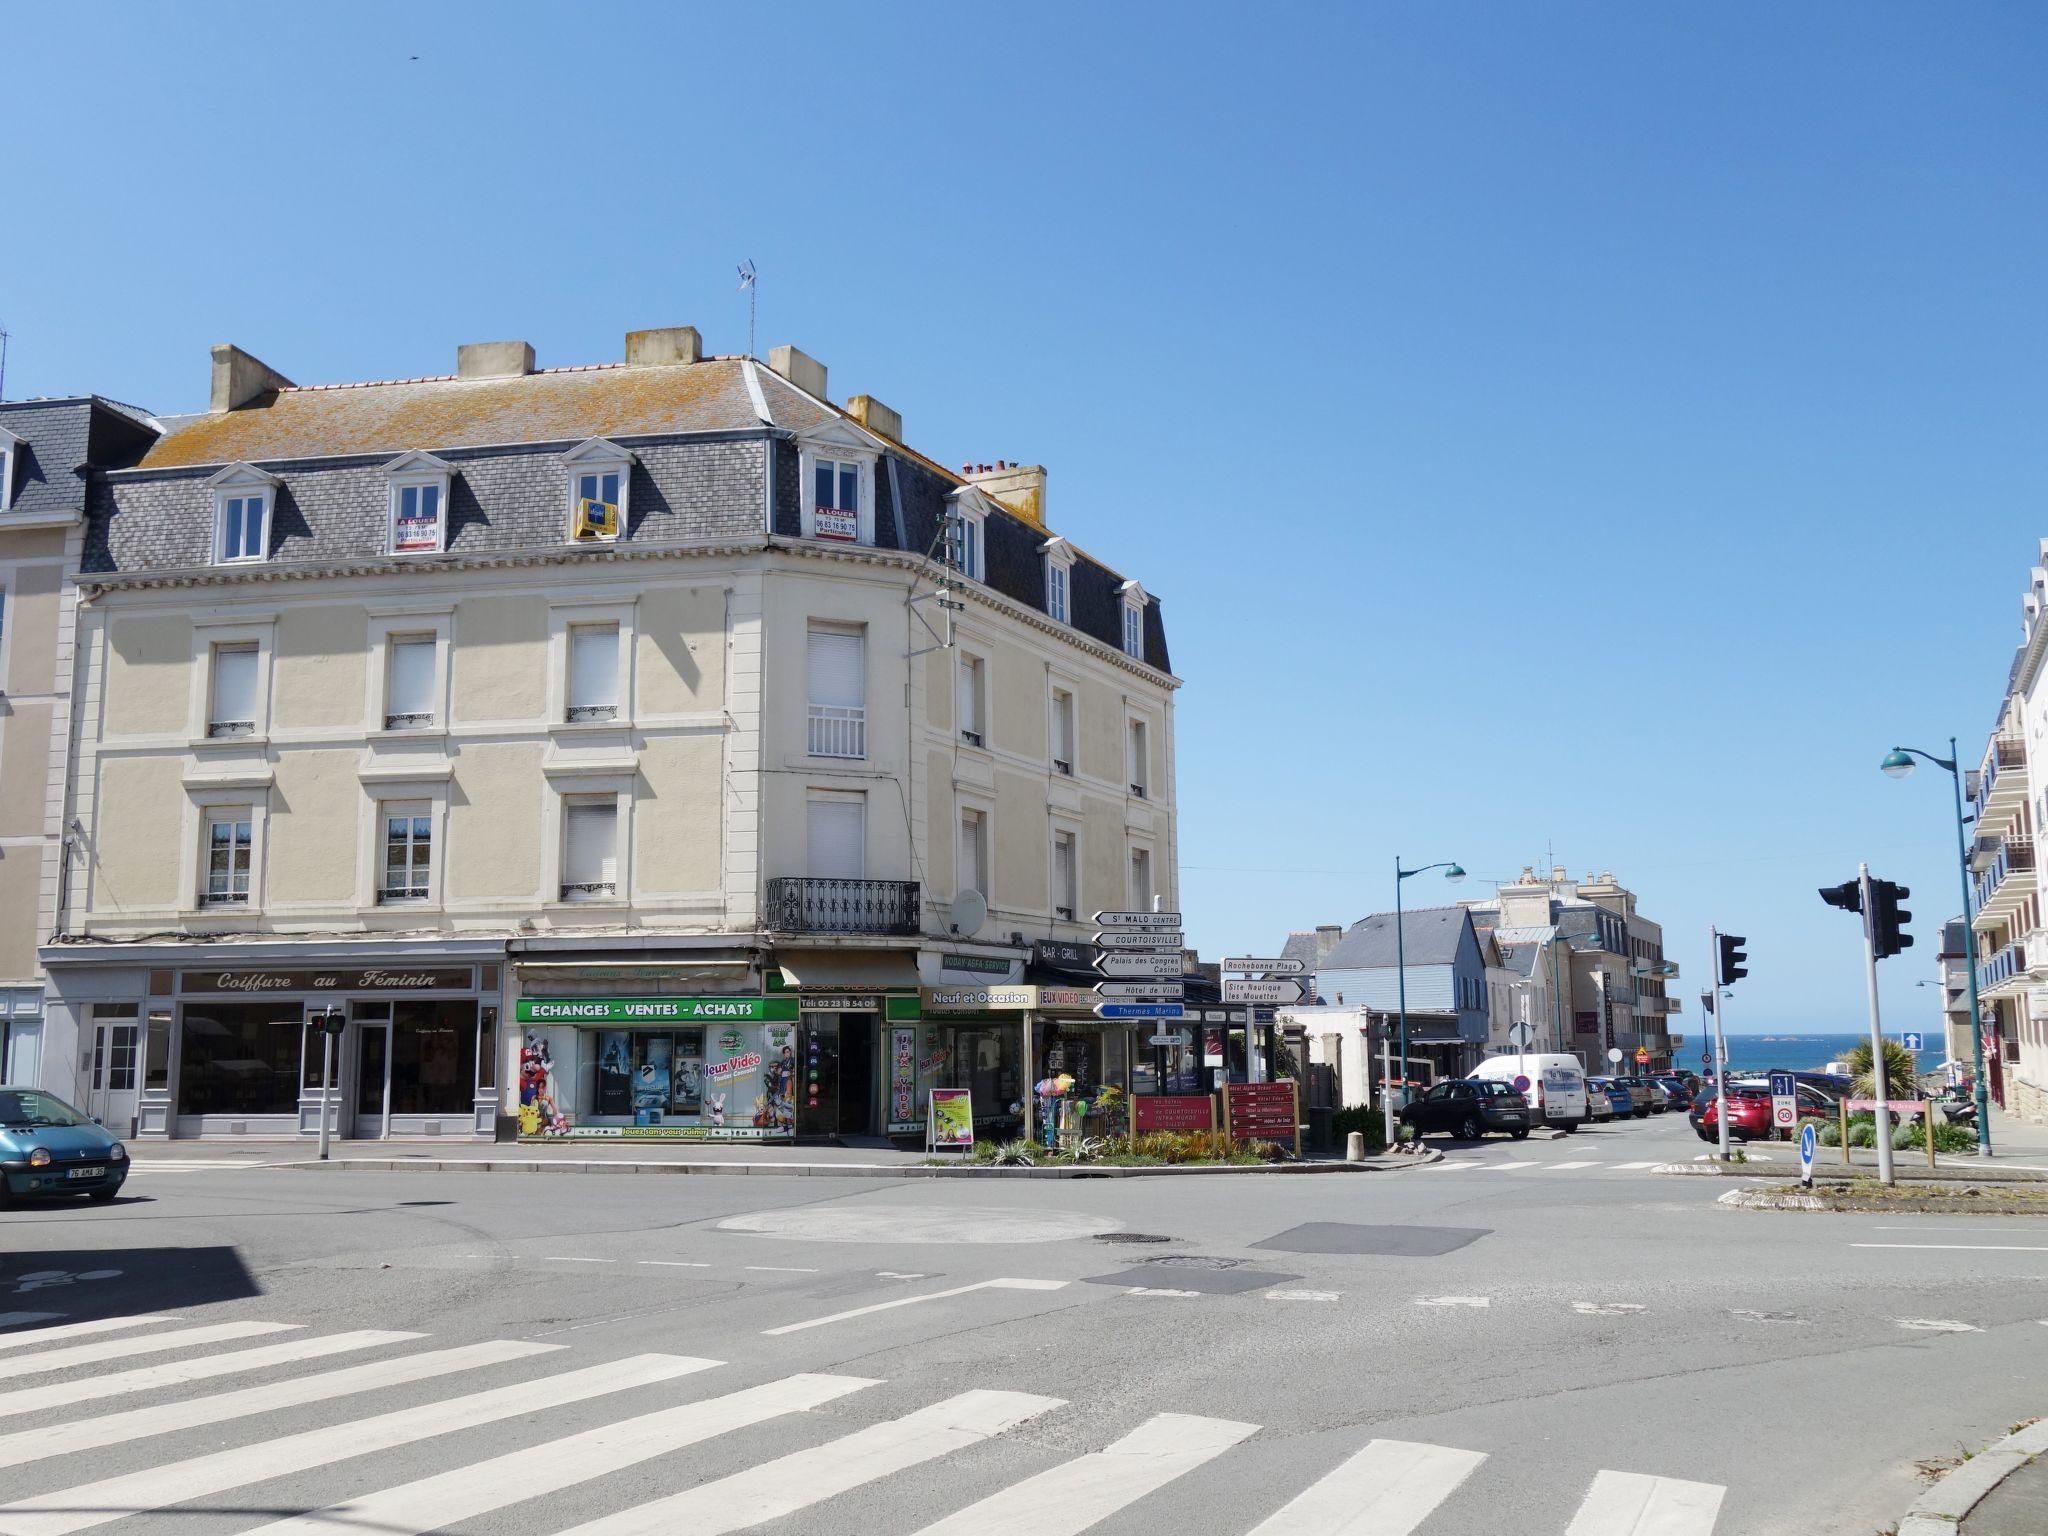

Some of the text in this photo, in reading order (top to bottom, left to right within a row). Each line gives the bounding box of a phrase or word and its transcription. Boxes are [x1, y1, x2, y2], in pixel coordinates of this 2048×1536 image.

[826, 509, 854, 518] LOUER
[407, 517, 436, 525] LOUER
[832, 521, 840, 530] 16
[1125, 915, 1149, 923] MALO
[1115, 936, 1179, 944] COURTOISVILLE
[1042, 948, 1057, 959] BAR
[1062, 948, 1078, 960] GRILL
[1110, 956, 1132, 965] Palais
[1150, 956, 1179, 966] Congrès
[1153, 965, 1179, 973] Casino
[1227, 961, 1298, 971] Rochebonne Plage
[216, 970, 438, 991] Coiffure au Féminin
[1125, 986, 1180, 994] Hôtel de Ville
[1228, 983, 1282, 992] Site Nautique
[932, 991, 1029, 1003] Neuf et Occasion
[1040, 991, 1057, 1004] JEUX
[1057, 992, 1079, 1004] VIDEO
[1243, 992, 1279, 1000] Mouettes
[531, 1004, 610, 1017] ECHANGES
[625, 1003, 678, 1016] VENTES
[693, 1003, 752, 1016] ACHATS
[1118, 1007, 1180, 1015] Thermes Marins
[704, 1052, 762, 1079] Jeux Vidéo
[713, 1073, 733, 1082] Toutes
[733, 1066, 758, 1077] Consoles
[899, 1034, 910, 1119] JEUX VIDEO
[622, 1127, 645, 1136] Jouez
[645, 1128, 663, 1136] sans
[662, 1128, 682, 1136] vous
[682, 1127, 707, 1136] ruiner
